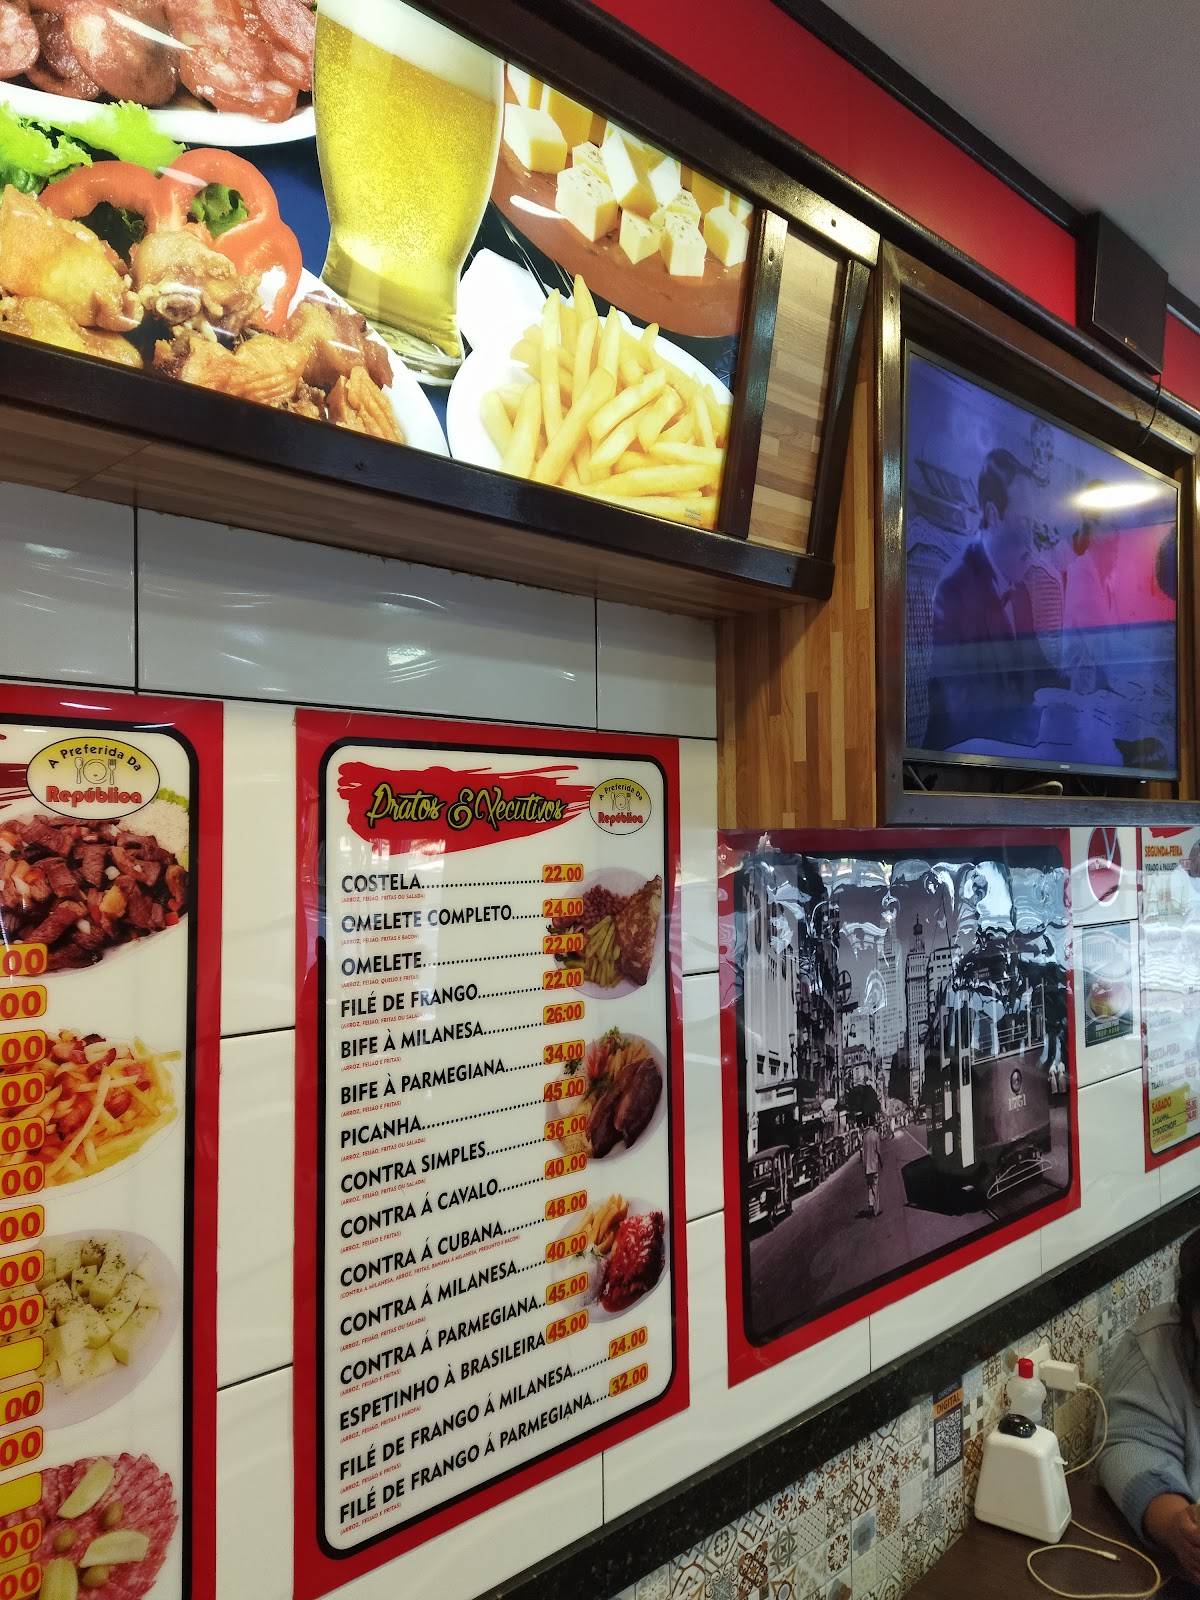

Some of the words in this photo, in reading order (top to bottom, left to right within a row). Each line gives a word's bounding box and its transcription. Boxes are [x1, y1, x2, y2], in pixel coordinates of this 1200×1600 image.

[48, 758, 60, 769] A
[60, 744, 125, 760] Preferida
[126, 755, 142, 772] Da
[46, 785, 143, 808] República
[366, 783, 446, 829] Pratos
[604, 783, 635, 794] Preferida
[635, 790, 643, 801] Da
[597, 811, 644, 827] República
[340, 872, 421, 893] COSTELA
[544, 864, 582, 882] 22.00
[340, 910, 422, 933] OMELETE
[427, 904, 512, 926] COMPLETO
[544, 898, 582, 916] 24.00
[340, 950, 422, 976] OMELETE
[544, 933, 582, 954] 22.00
[340, 989, 376, 1017] FILÉ
[382, 992, 404, 1012] DE
[410, 982, 478, 1008] FRANGO
[544, 968, 582, 990] 22.00
[340, 1035, 377, 1059] BIFE
[400, 1019, 483, 1049] MILANESA
[340, 1080, 377, 1105] BIFE
[401, 1056, 506, 1093] PARMEGIANA
[545, 1040, 583, 1065] 34.00
[340, 1113, 422, 1149] PICANHA
[340, 1157, 416, 1194] CONTRA
[421, 1139, 486, 1173] SIMPLES
[546, 1113, 586, 1141] 36.00
[340, 1200, 416, 1240] CONTRA
[437, 1176, 498, 1211] CAVALO
[545, 1151, 586, 1179] 40.00
[340, 1246, 416, 1288] CONTRA
[437, 1219, 503, 1256] CUBANA
[546, 1190, 586, 1220] 48.00
[340, 1292, 416, 1337] CONTRA
[437, 1257, 517, 1302] MILANESA
[547, 1232, 587, 1262] 40.00
[340, 1339, 416, 1386] CONTRA
[438, 1292, 538, 1348] PARMEGIANA
[547, 1274, 586, 1305] 45.00
[339, 1372, 439, 1431] ESPETINHO
[460, 1329, 545, 1380] BRASILEIRA
[548, 1310, 587, 1344] 45.00
[339, 1441, 376, 1482] FILÉ
[382, 1435, 405, 1462] DE
[410, 1402, 480, 1450] FRANGO
[499, 1360, 573, 1410] MILANESA
[610, 1327, 645, 1358] 24.00
[936, 1391, 960, 1414] DIGITAL
[339, 1484, 376, 1525] FILÉ
[382, 1476, 405, 1504] DE
[410, 1441, 480, 1492] FRANGO
[499, 1388, 592, 1449] PARMEGIANA
[612, 1362, 646, 1395] 32.00
